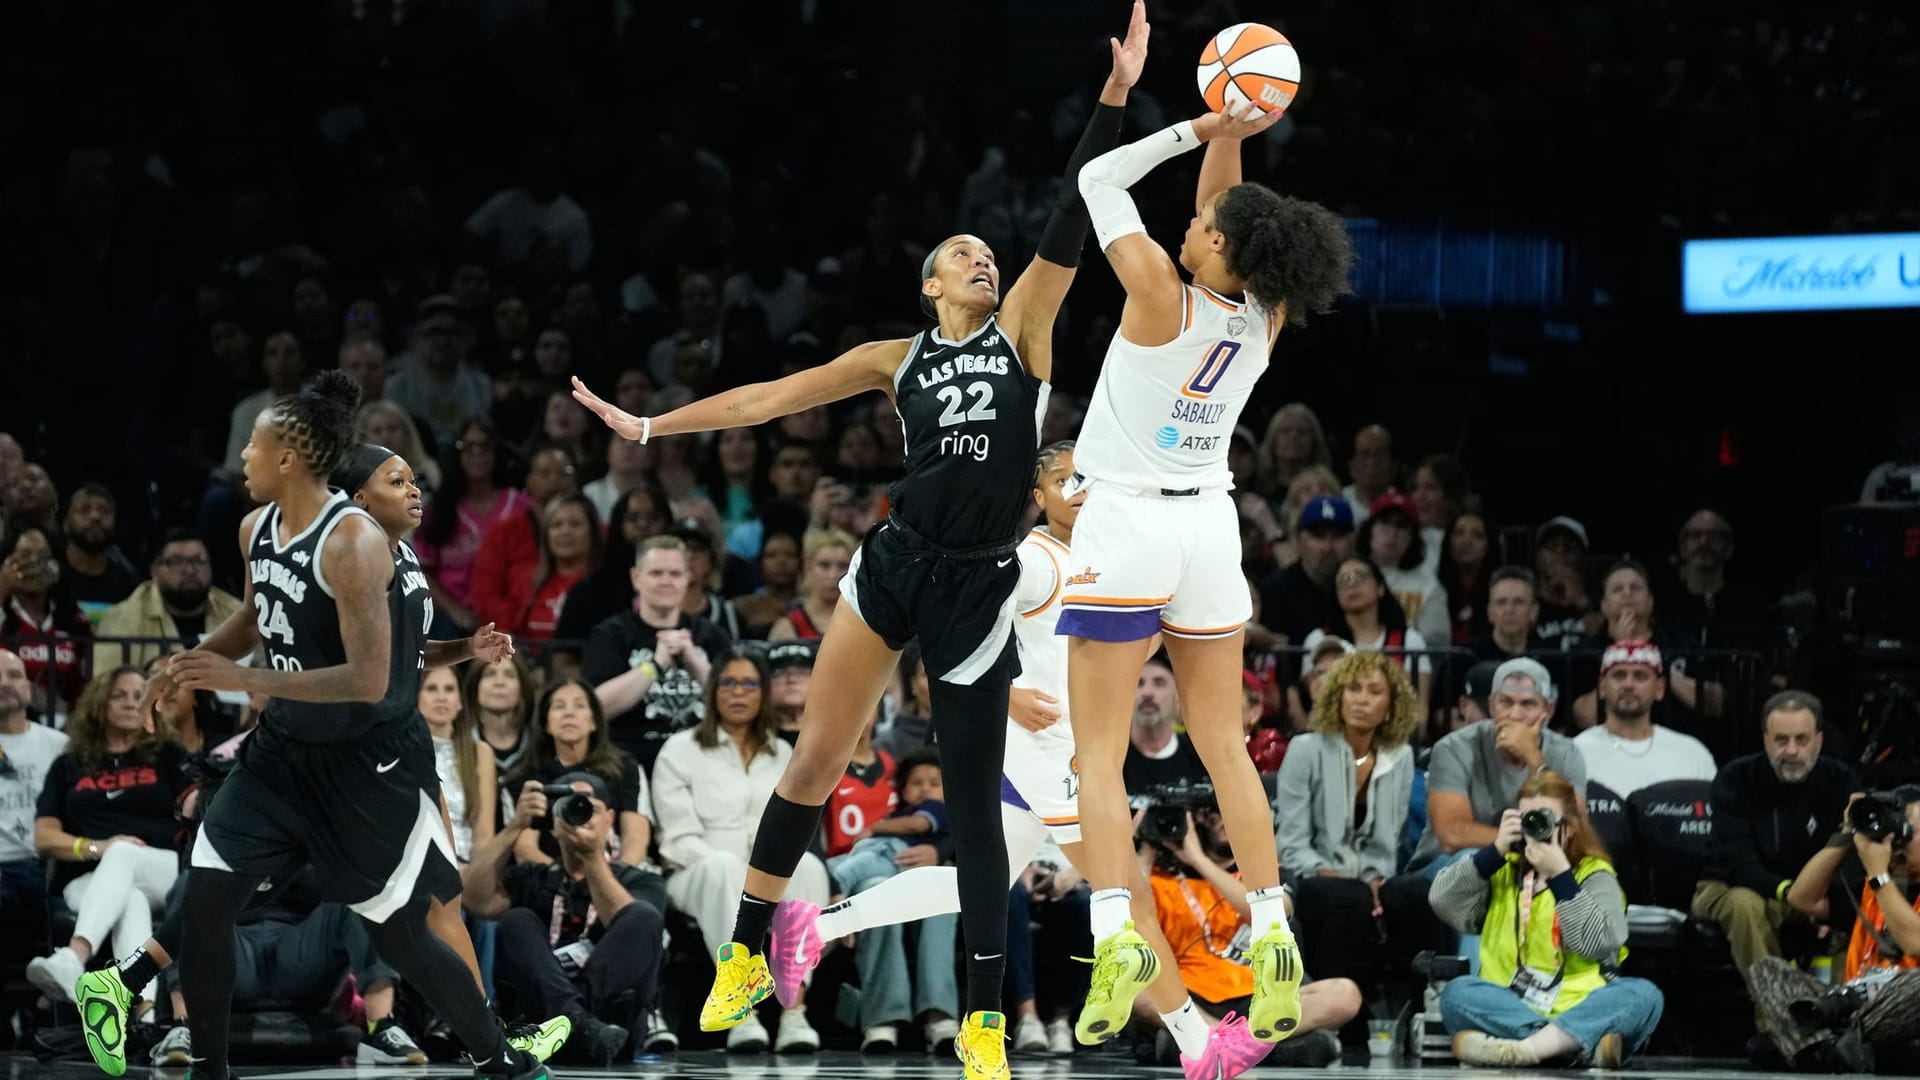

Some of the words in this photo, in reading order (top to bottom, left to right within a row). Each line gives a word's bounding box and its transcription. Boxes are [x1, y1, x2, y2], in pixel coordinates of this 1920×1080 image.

[1722, 253, 1879, 299] Michelob
[982, 334, 1000, 347] ally
[917, 361, 954, 389] LAS
[953, 354, 1009, 376] VEGAS
[1181, 340, 1242, 399] 0
[936, 381, 996, 427] 22
[1171, 399, 1226, 424] SABALLY
[941, 431, 989, 461] ring
[1180, 435, 1221, 450] AT&T
[250, 558, 270, 584] LAS
[269, 560, 307, 604] VEGAS
[254, 592, 294, 645] 24
[648, 678, 704, 695] ACES
[75, 768, 158, 792] ACES
[839, 803, 865, 836] 0
[1586, 800, 1621, 814] TRA
